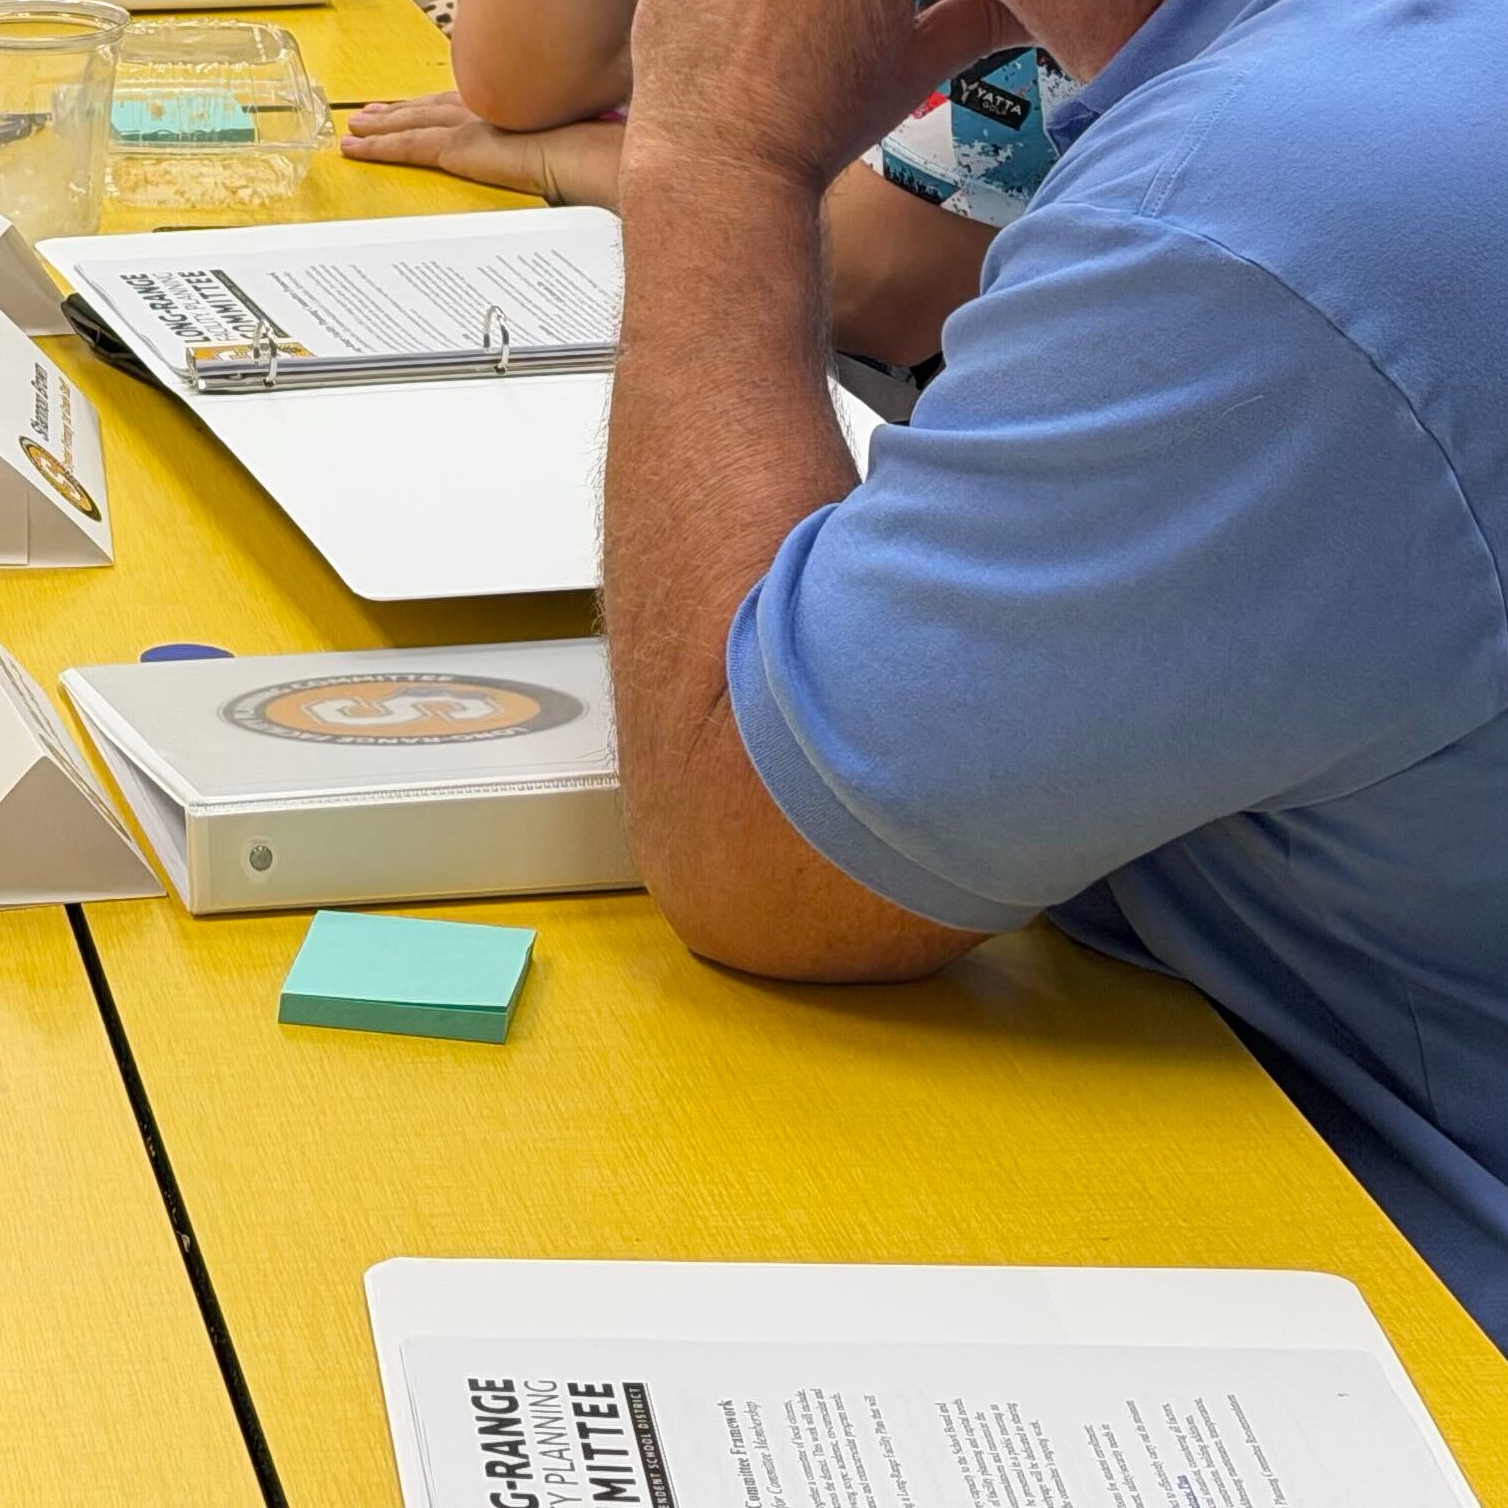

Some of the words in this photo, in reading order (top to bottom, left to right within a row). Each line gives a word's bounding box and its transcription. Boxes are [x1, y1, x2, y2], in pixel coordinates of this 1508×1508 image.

[976, 86, 1022, 116] YATTA
[120, 272, 211, 343] LONG-RANGE
[177, 270, 269, 341] COMMITTEE
[31, 362, 49, 400] Brown
[30, 394, 49, 442] Shannon
[629, 1386, 650, 1430] DISTRICT
[717, 1400, 747, 1455] Framework
[744, 1402, 769, 1451] Membership
[875, 1421, 886, 1434] Plan
[524, 1380, 579, 1485] PLANNING
[644, 1432, 660, 1470] SCHOOL
[812, 1444, 824, 1456] This
[738, 1458, 762, 1508] Committee
[761, 1453, 782, 1494] Committee
[889, 1459, 908, 1496] Long-Range
